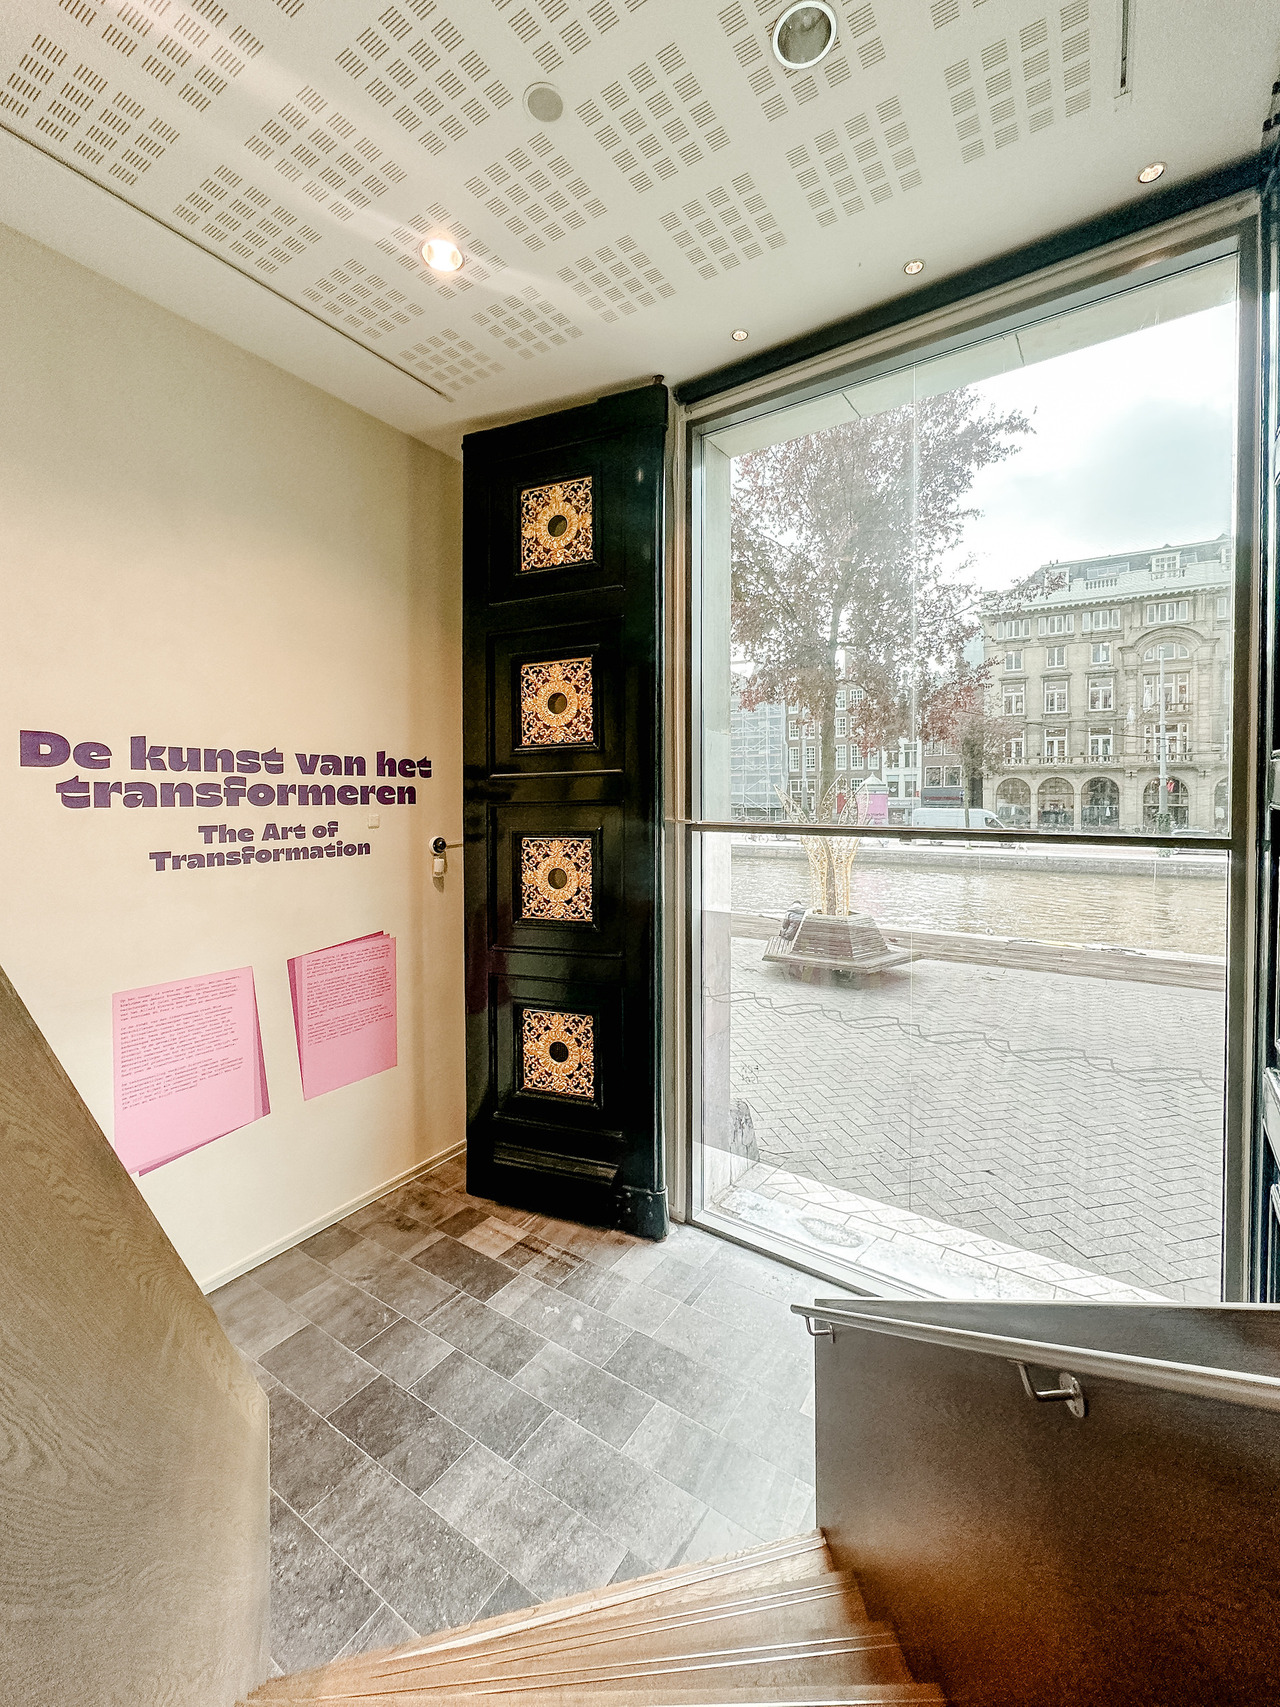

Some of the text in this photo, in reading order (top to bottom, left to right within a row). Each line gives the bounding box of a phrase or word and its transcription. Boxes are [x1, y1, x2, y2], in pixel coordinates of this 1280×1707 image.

[19, 729, 433, 779] De kunst van het
[55, 775, 417, 809] transformeren
[197, 820, 339, 845] The Art of
[148, 840, 371, 872] Transformation
